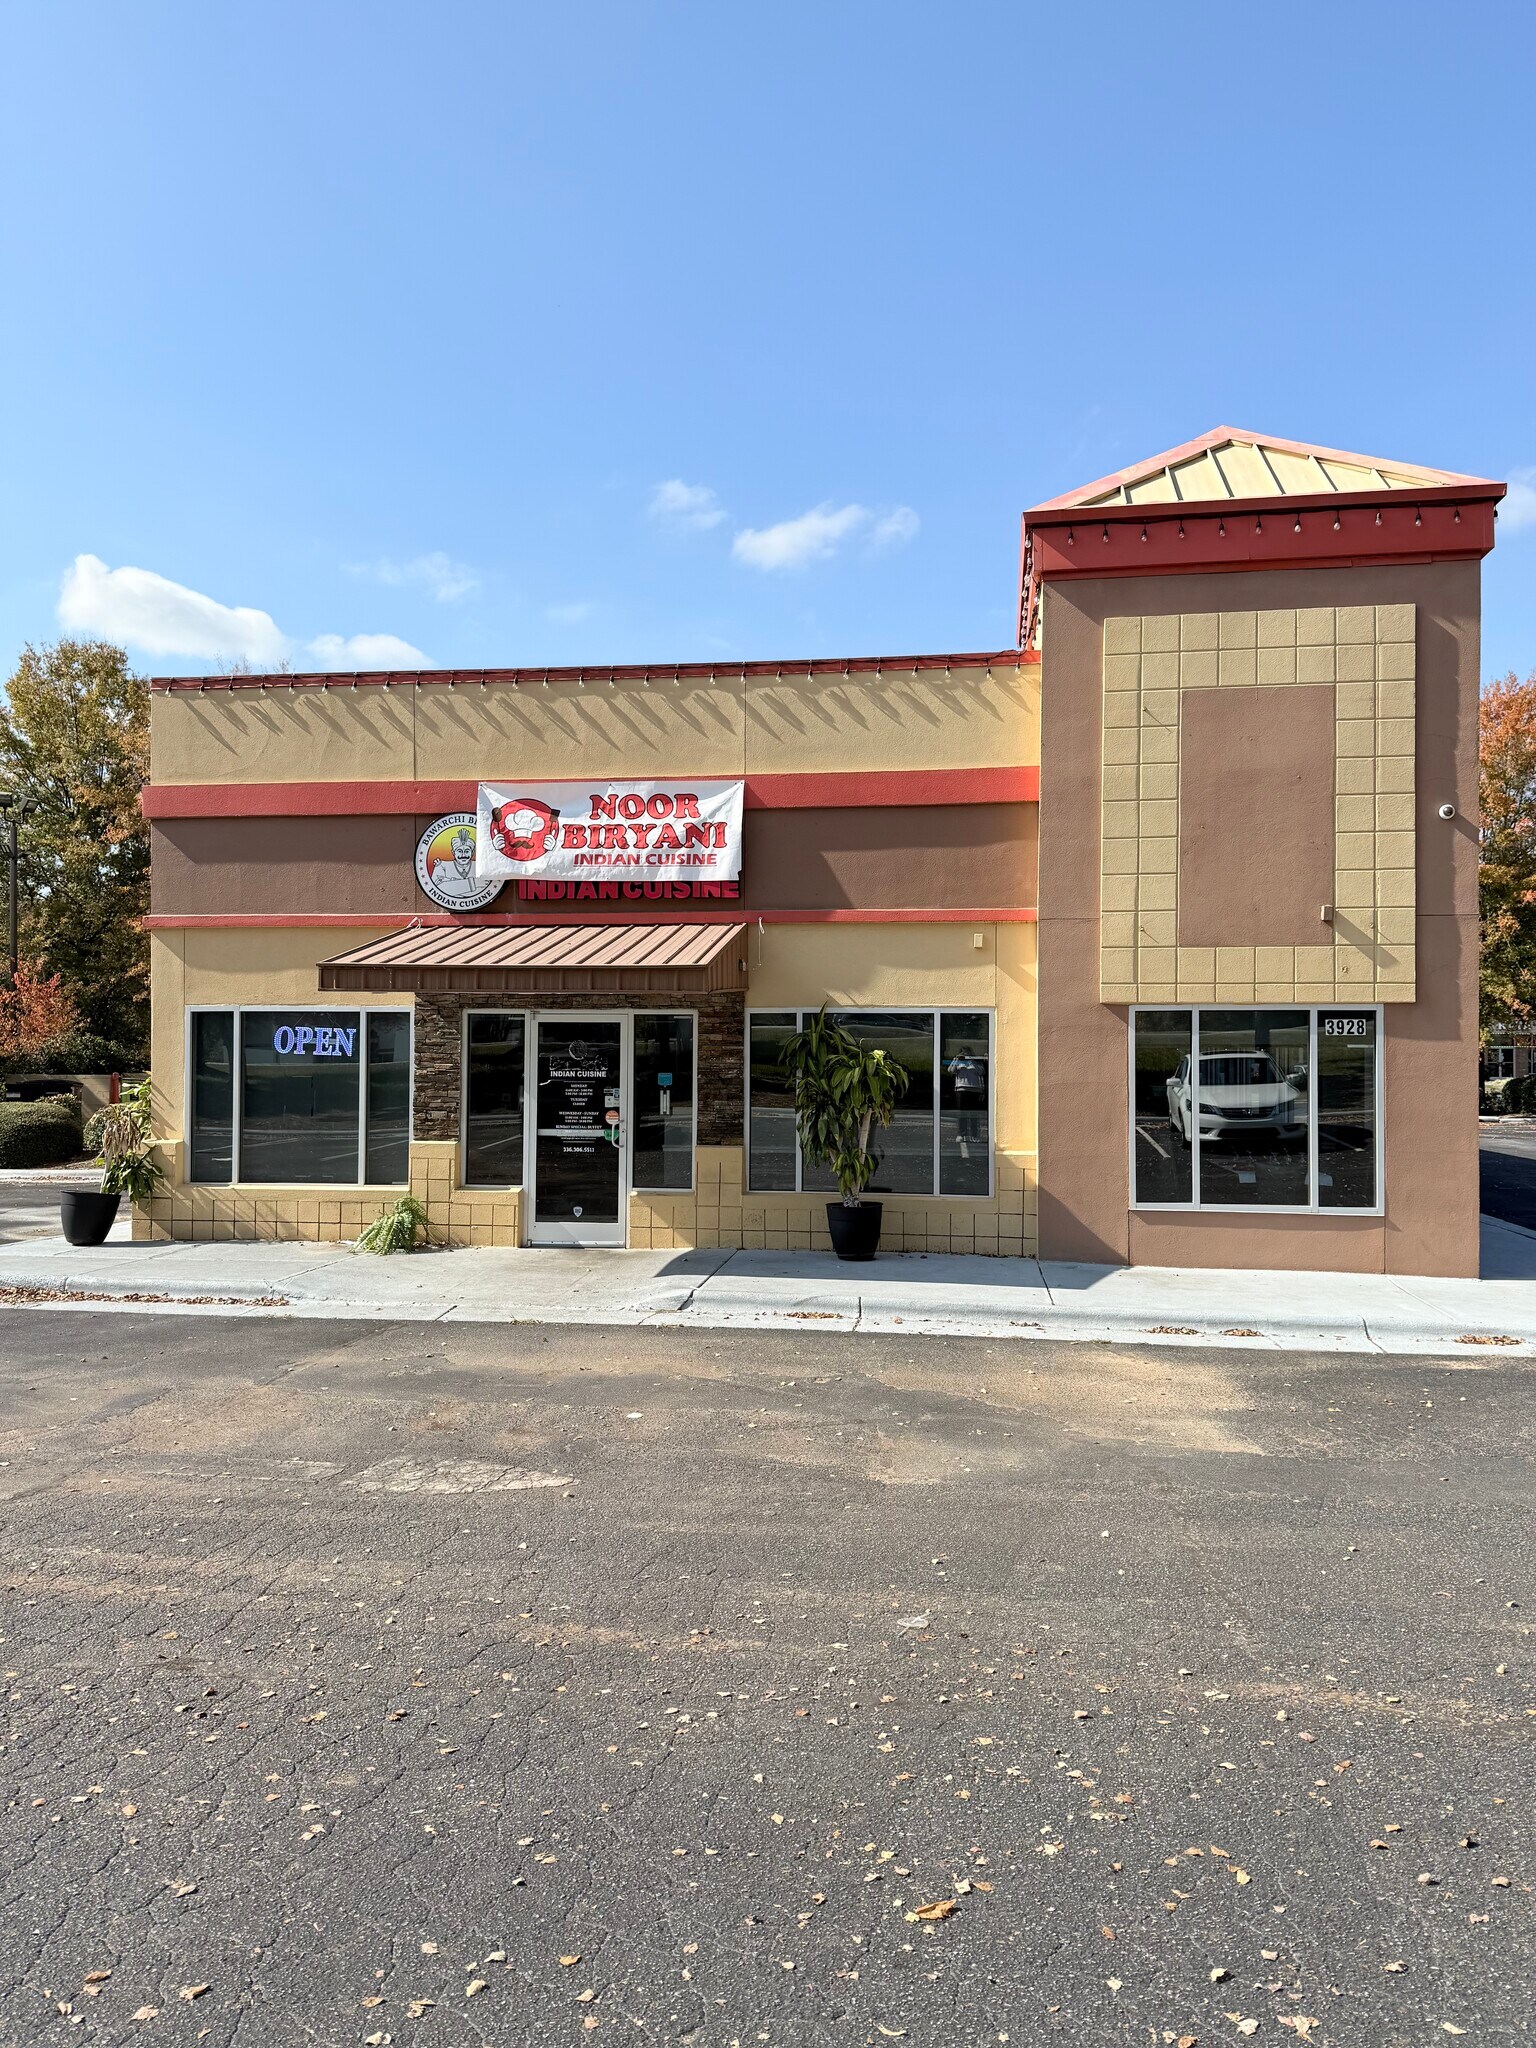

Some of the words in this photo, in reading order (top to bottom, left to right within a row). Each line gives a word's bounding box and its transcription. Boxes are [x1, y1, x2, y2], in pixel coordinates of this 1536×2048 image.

[589, 793, 701, 820] NOOR
[422, 815, 465, 846] BAWARCHI
[561, 821, 728, 850] BIRYANI
[573, 853, 641, 865] INDIAN
[645, 853, 717, 865] CUISINE
[428, 887, 457, 907] INDIAN
[459, 889, 493, 908] CUISINE
[518, 880, 619, 900] INDIAN
[622, 880, 740, 899] CUISINE
[1326, 1019, 1365, 1035] 3928
[273, 1025, 357, 1057] OPEN
[577, 1070, 607, 1078] CUISINE
